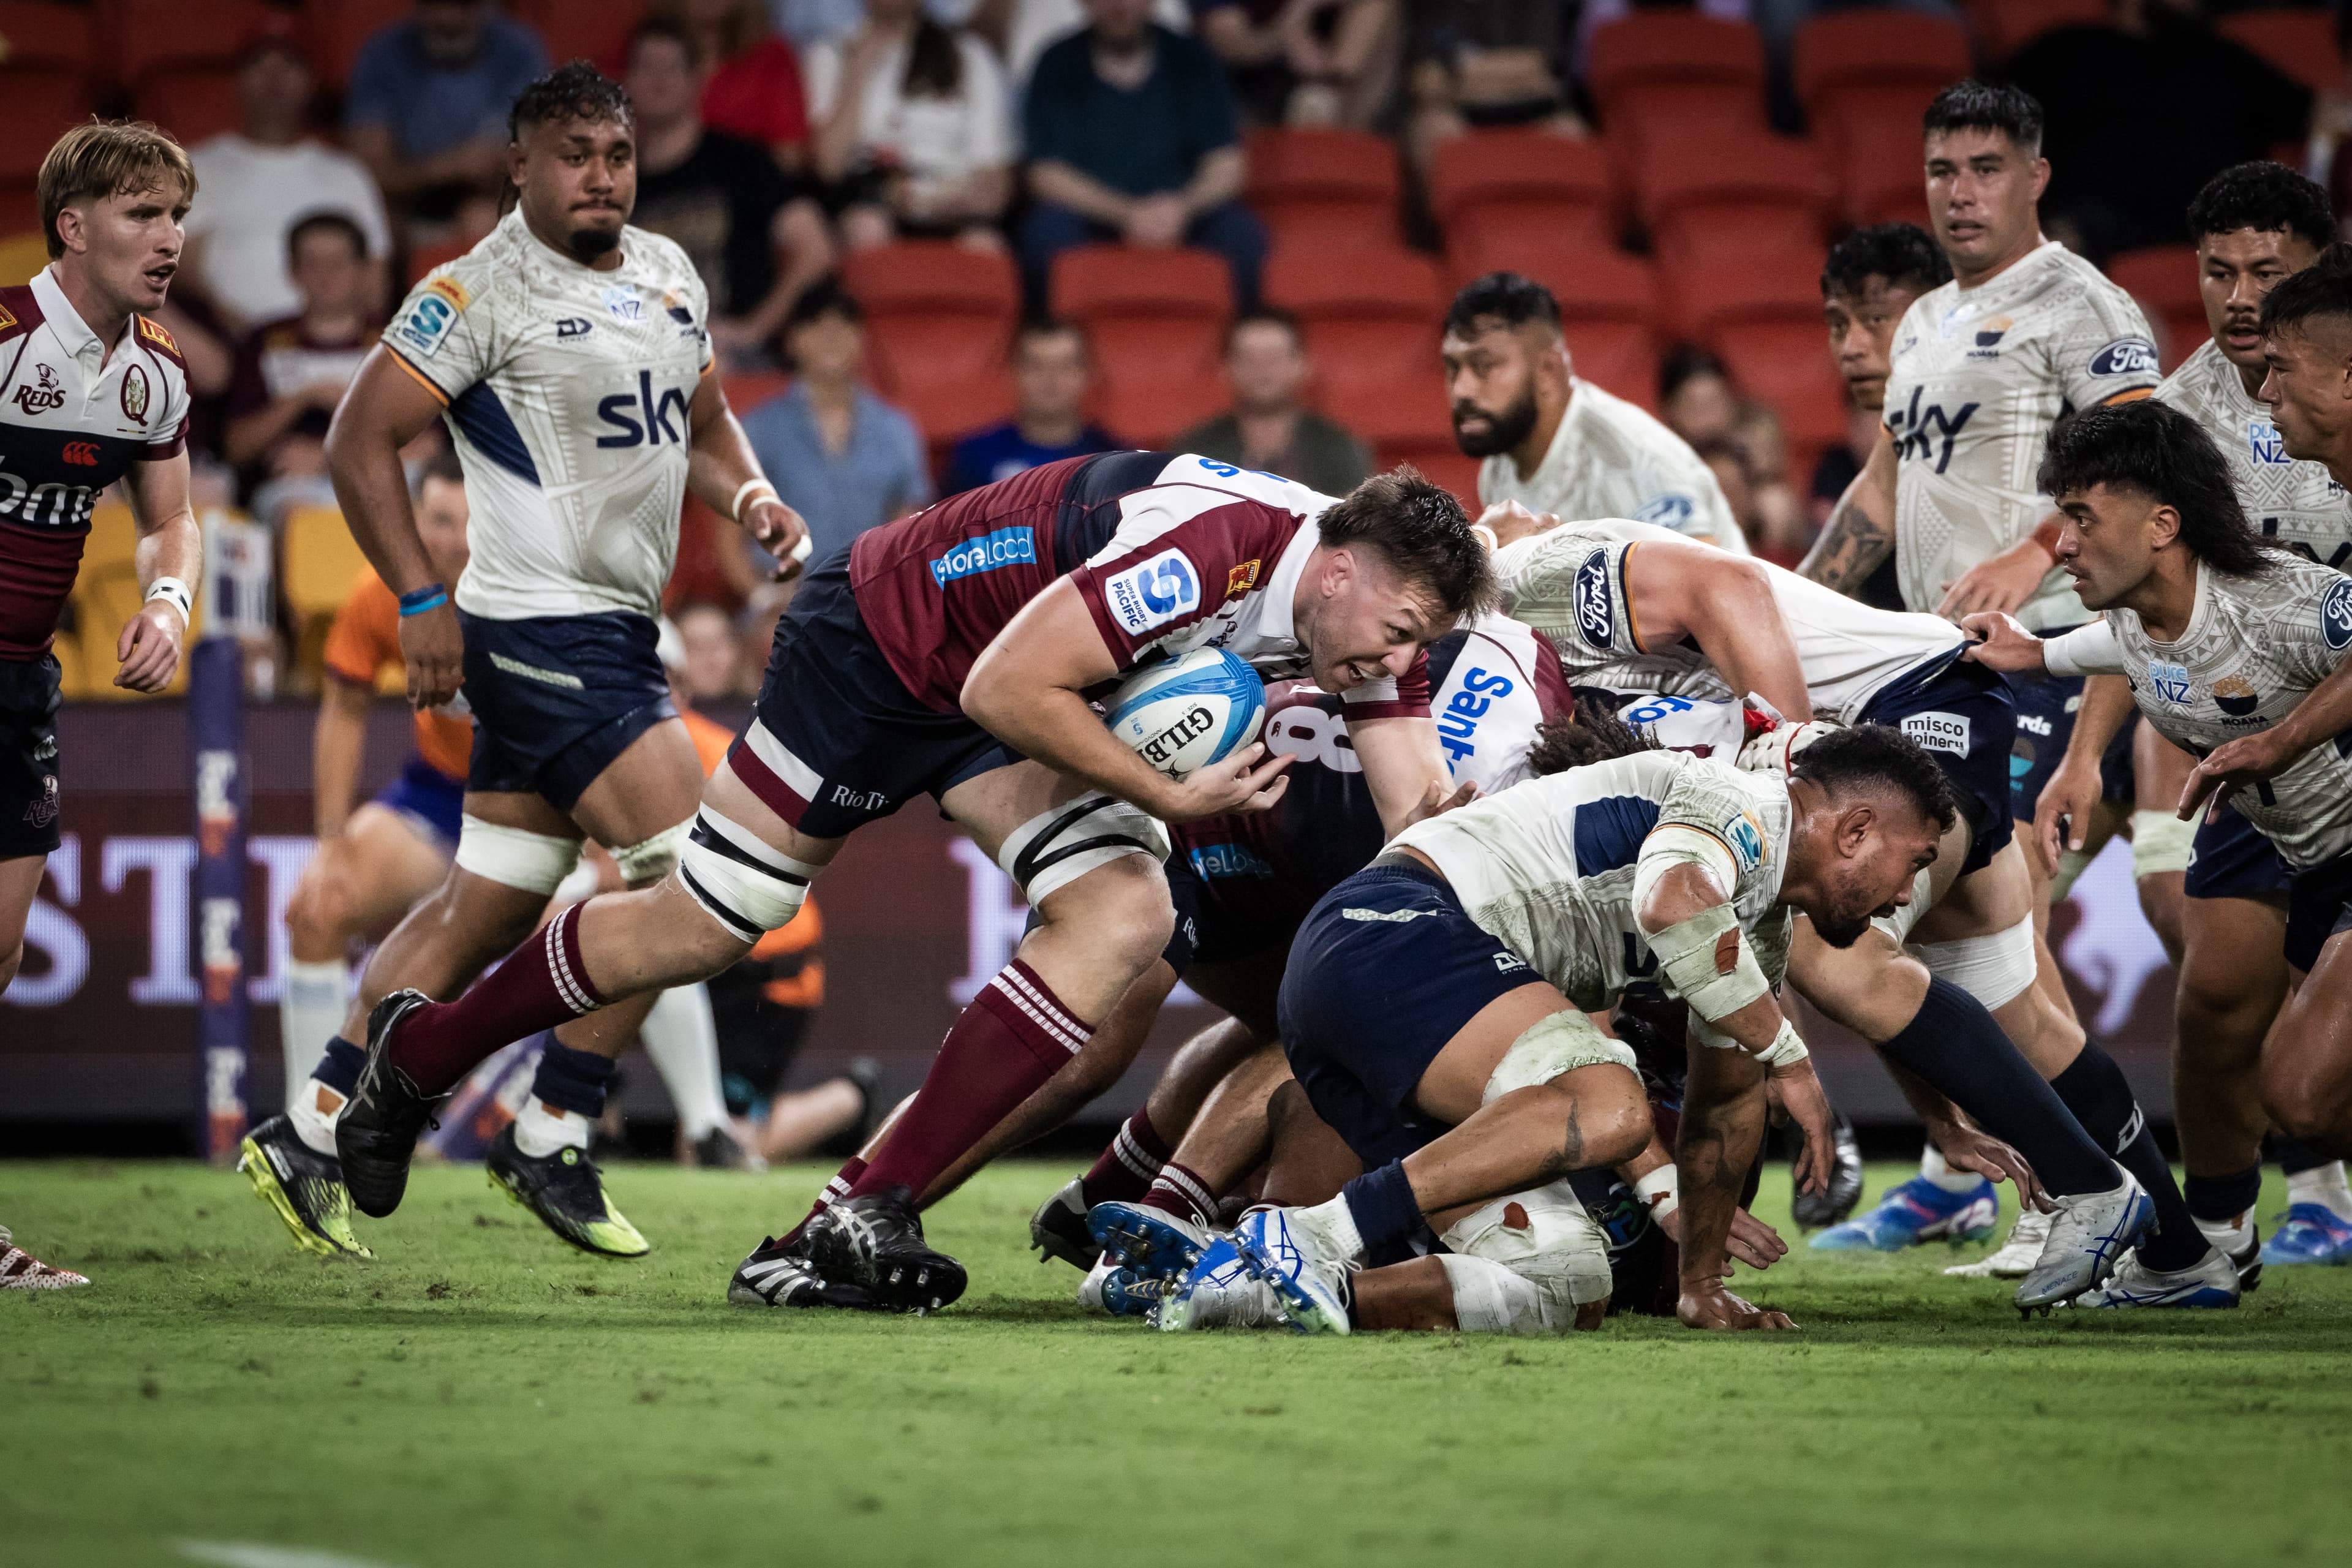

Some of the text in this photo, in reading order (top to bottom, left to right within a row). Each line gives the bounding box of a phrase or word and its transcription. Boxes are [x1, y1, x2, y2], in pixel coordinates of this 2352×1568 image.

[2109, 344, 2160, 373] For
[11, 384, 66, 415] REDS
[2250, 423, 2282, 447] pu
[2253, 440, 2291, 464] NZ
[1112, 582, 1140, 627] PACIFIC
[1123, 578, 1148, 623] SUPER RUGBY
[1580, 565, 1610, 637] Ford
[2149, 662, 2187, 682] pure
[2155, 678, 2193, 704] NZ
[1436, 667, 1514, 779] Sant
[1907, 716, 1964, 737] misco
[2220, 715, 2269, 726] MOANA
[1136, 707, 1214, 767] GILB
[1265, 705, 1363, 774] 8
[1502, 966, 1533, 975] DYNAS
[2041, 1270, 2078, 1295] MENACE
